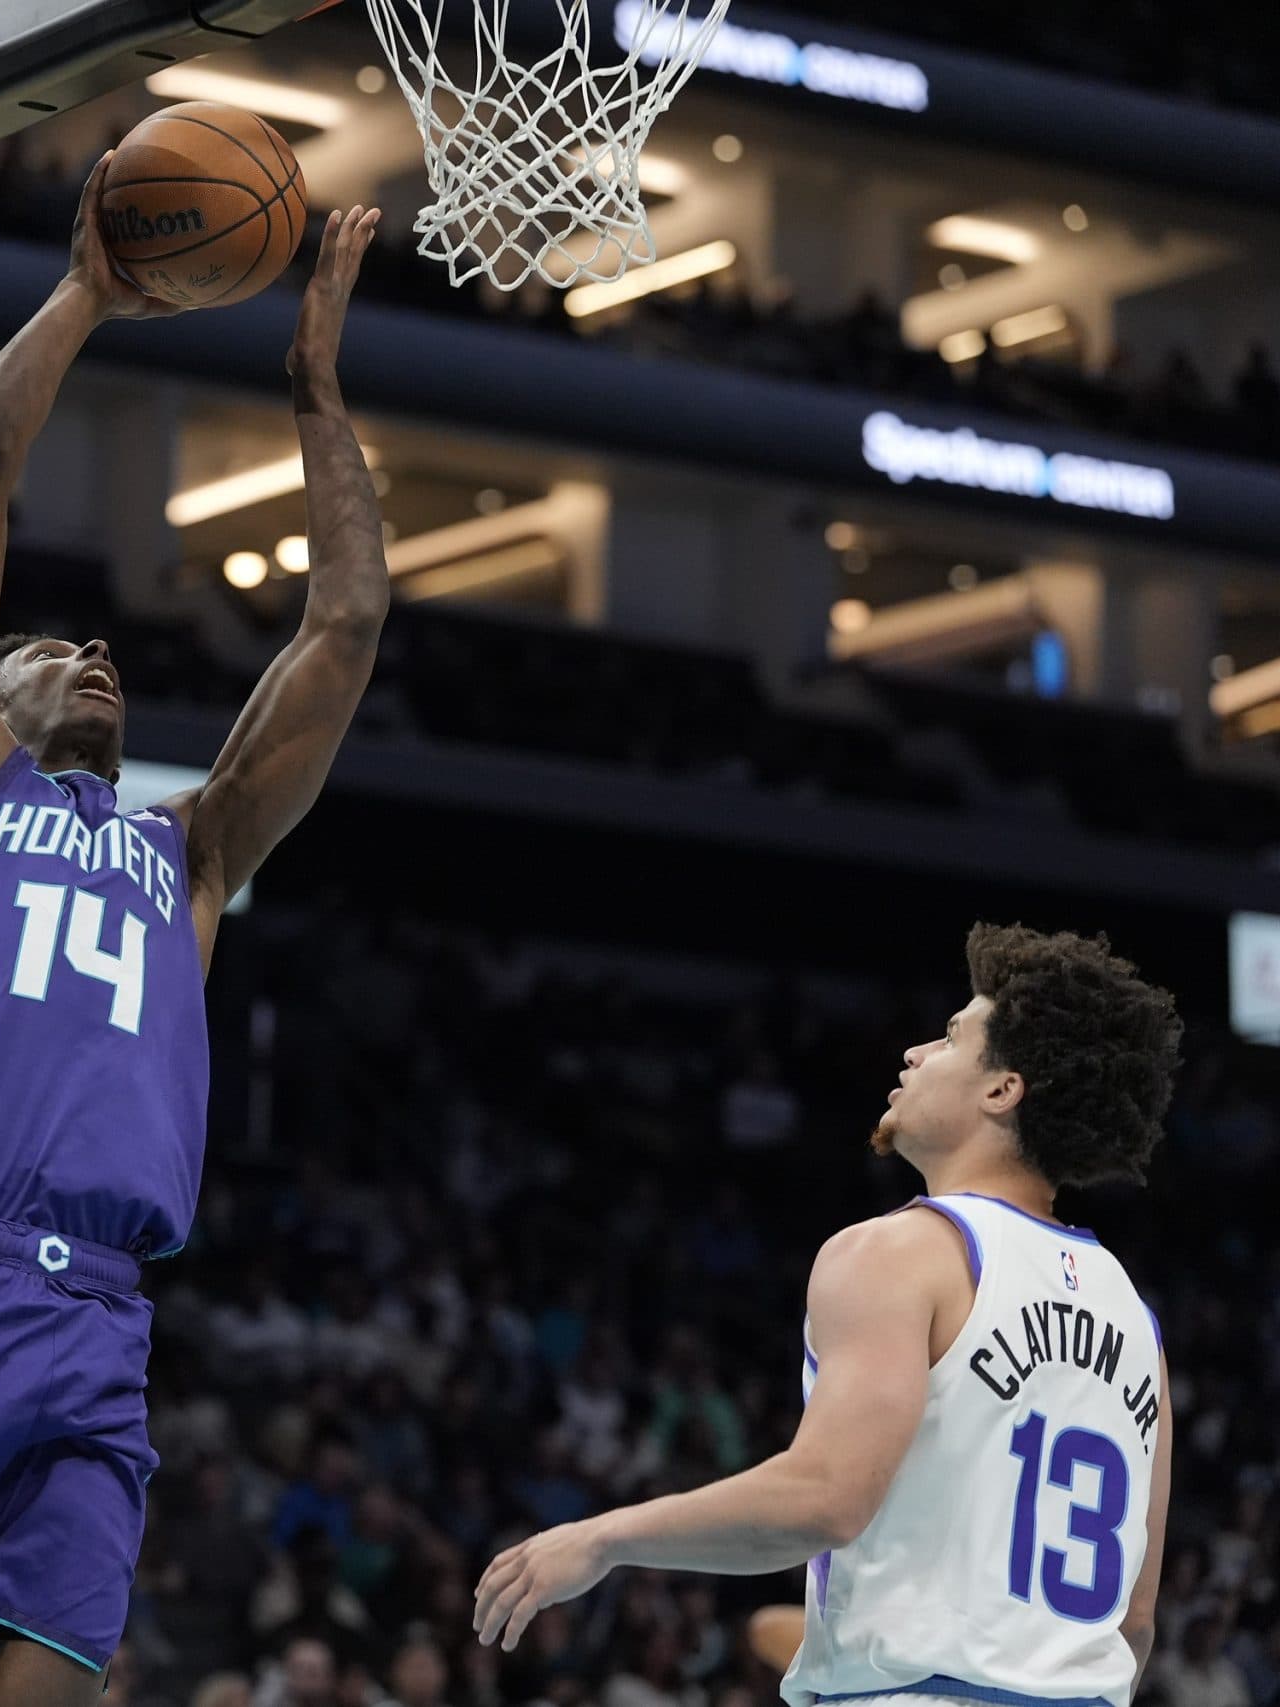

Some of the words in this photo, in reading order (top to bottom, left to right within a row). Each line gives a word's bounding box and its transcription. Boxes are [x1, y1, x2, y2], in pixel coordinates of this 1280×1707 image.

[9, 880, 148, 1036] 14
[969, 1300, 1124, 1401] CLAYTON
[1123, 1374, 1159, 1456] JR.
[1007, 1407, 1131, 1625] 13
